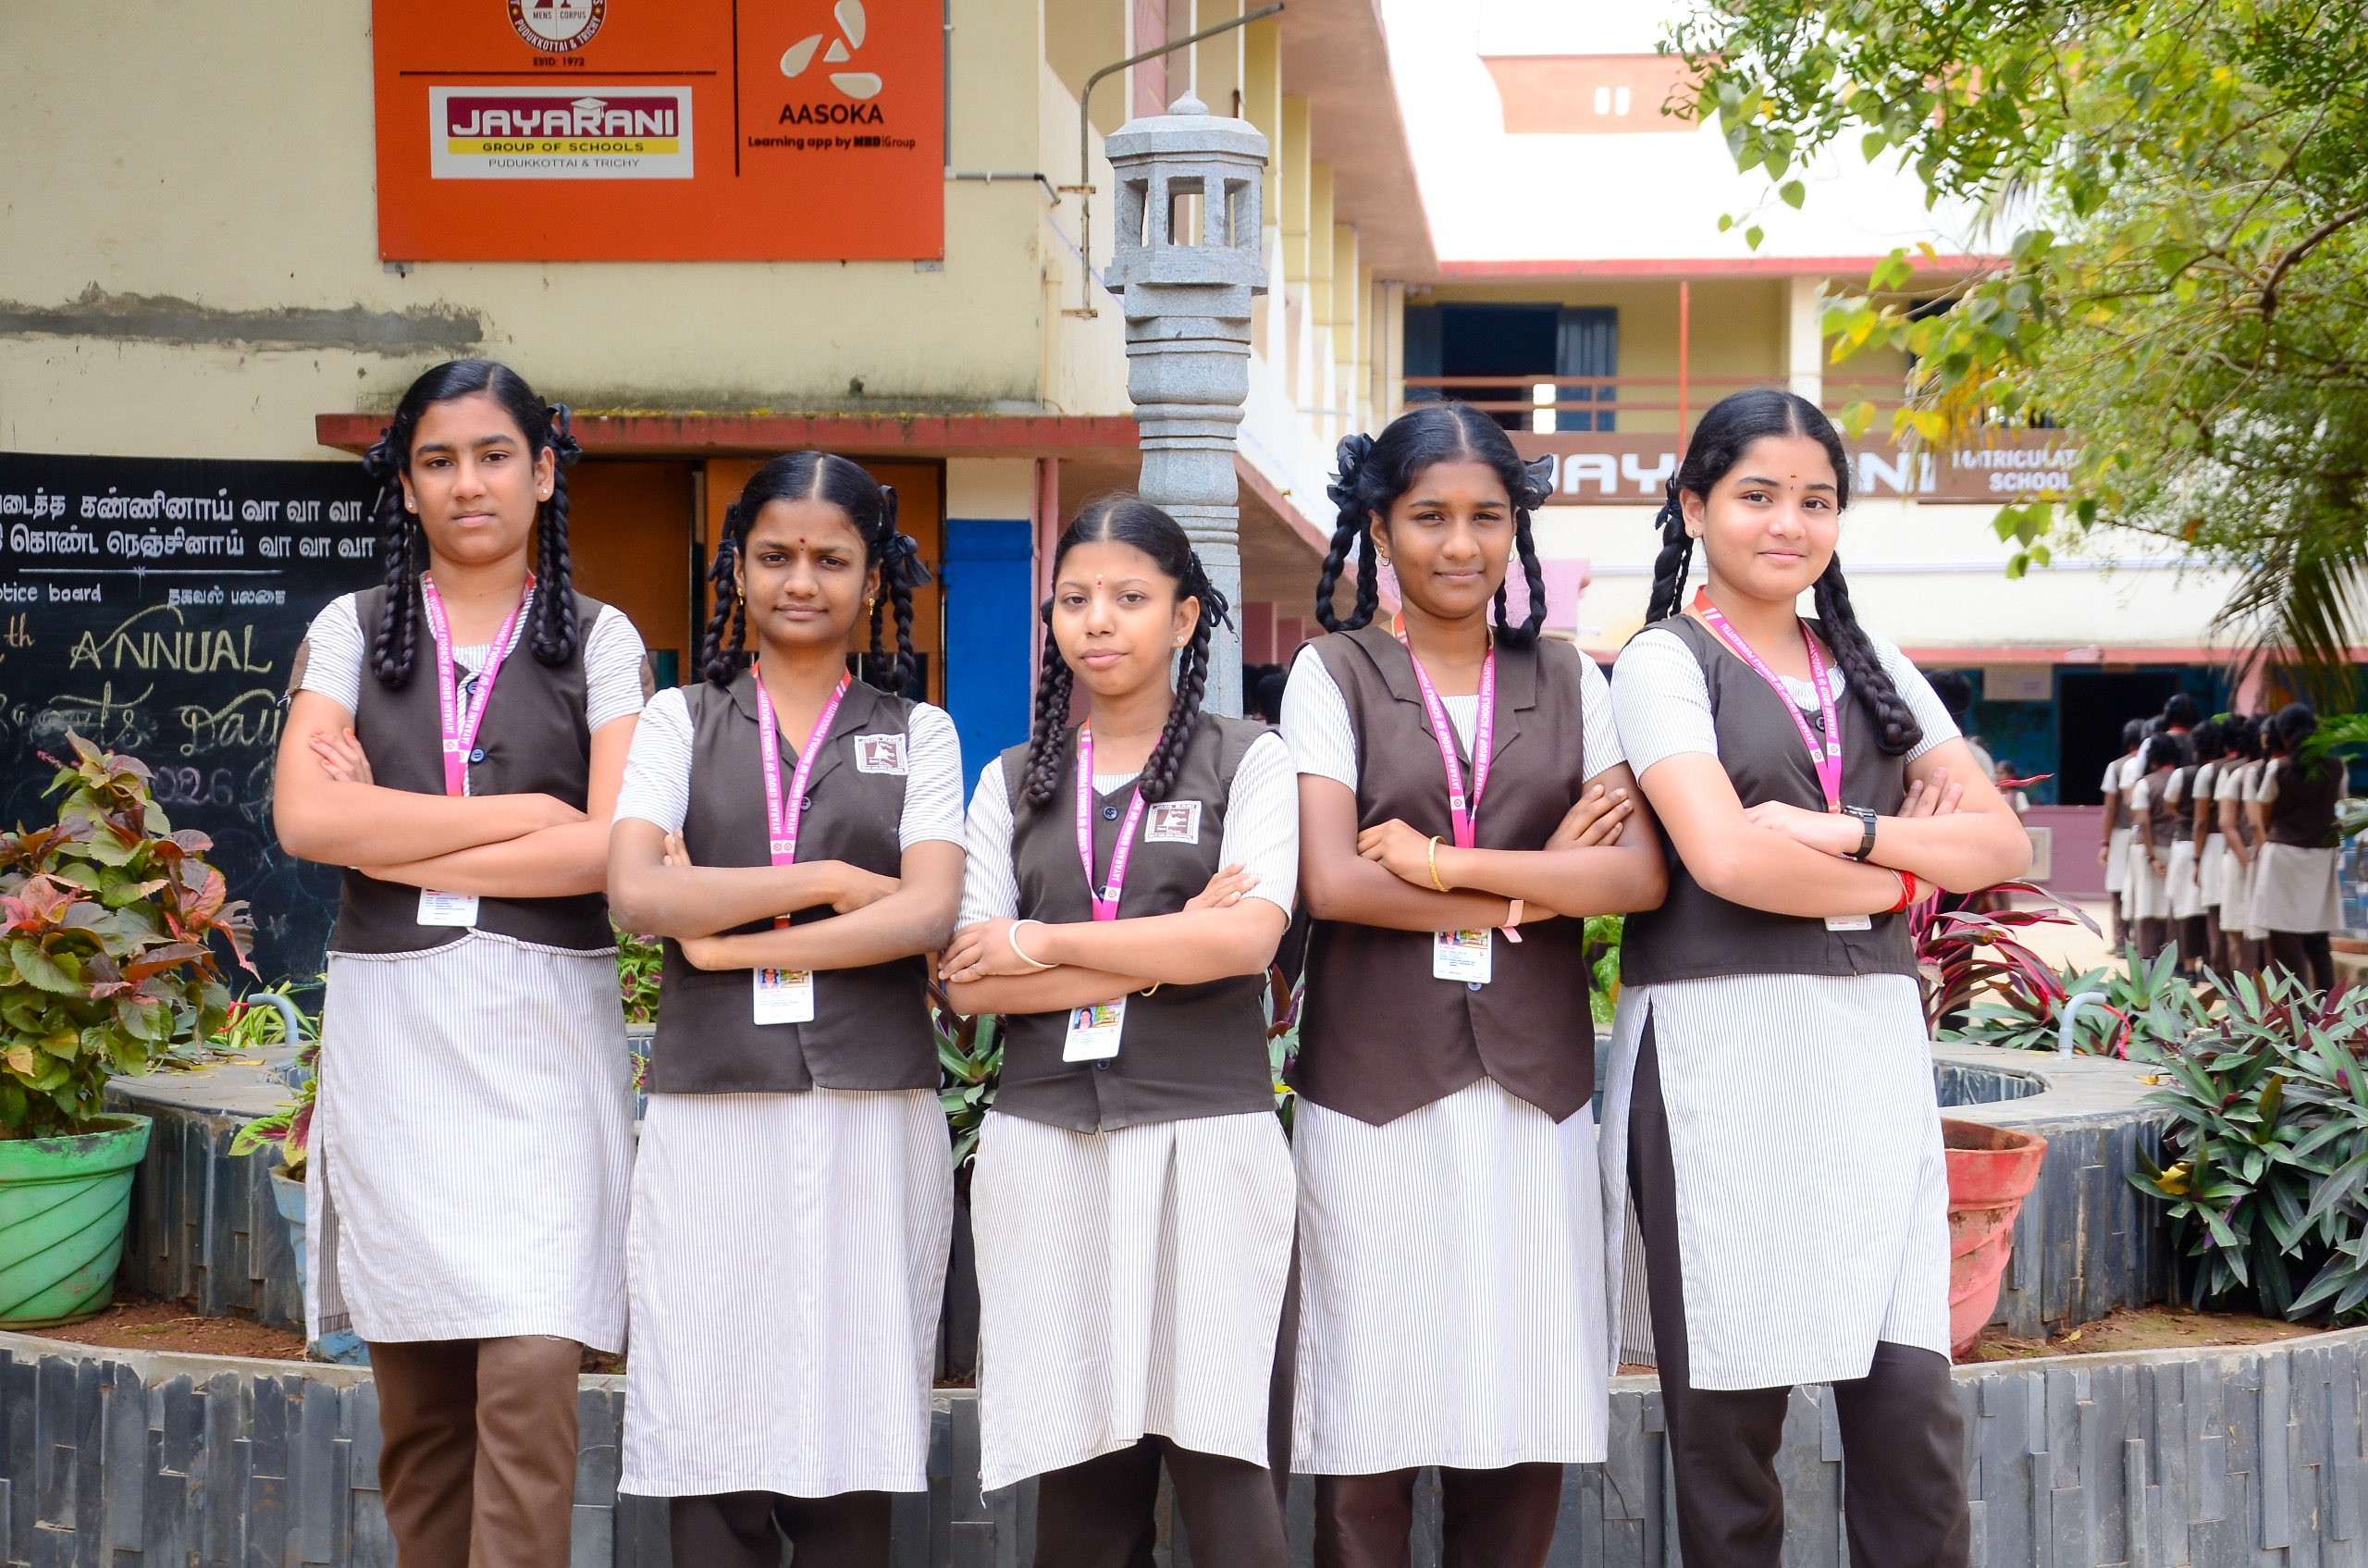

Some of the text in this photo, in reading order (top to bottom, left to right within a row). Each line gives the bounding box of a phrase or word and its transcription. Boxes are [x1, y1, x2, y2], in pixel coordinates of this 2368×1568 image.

[533, 10, 586, 19] MENS CORPUS
[514, 15, 601, 53] PUDUKKOTTAI & TRICHY
[562, 56, 586, 67] 1972
[451, 106, 674, 136] JAYARANI
[778, 104, 884, 125] AASOKA
[482, 142, 645, 152] GROUP OF SCHOOLS
[748, 135, 805, 150] Learning
[807, 137, 832, 151] app
[835, 135, 851, 151] by
[884, 135, 917, 151] Group
[488, 158, 640, 167] PUDUKKOTTAI & TRICHY
[1989, 471, 2073, 492] SCHOOL
[0, 487, 66, 520] டைத்த
[80, 486, 233, 522] கண்ணினாய்
[241, 499, 279, 522] வா
[286, 500, 320, 523] வா
[10, 523, 99, 553] கொண்ட
[106, 526, 244, 560] நெஞ்சினாய்
[259, 536, 291, 558] வா
[299, 536, 331, 558] வா
[338, 537, 376, 558] வா
[0, 581, 102, 603] tice board
[168, 585, 287, 608] தகவல் பலகை
[69, 608, 273, 674] ANNUAL
[438, 634, 450, 664] SCHOOLS
[441, 665, 450, 675] OF
[484, 647, 501, 676] SCHOOLS
[441, 676, 452, 700] GROUP
[480, 676, 490, 686] OF
[1720, 623, 1817, 744] JAYARANI GROUP OF SCHOOLS PUDUKKOTTAI
[472, 686, 487, 710] GROUP
[1819, 685, 1832, 707] GROUP
[444, 701, 455, 734] JAYARANI
[1480, 697, 1491, 728] SCHOOLS
[461, 711, 478, 745] JAYARANI
[1425, 688, 1461, 791] JAYARANI GROUP OF SCHOOLS
[1480, 728, 1488, 738] OF
[763, 730, 774, 761] SCHOOLS
[1478, 738, 1488, 764] GROUP
[766, 762, 775, 772] OF
[786, 700, 839, 834] JAYARANI GROUP OF SCHOOLS PUDUKKOTTAI
[767, 772, 778, 798] GROUP
[1474, 765, 1486, 799] JAYARANI
[770, 799, 782, 834] JAYARANI
[1078, 818, 1088, 827] OF
[1078, 827, 1088, 852] GROUP
[1112, 846, 1128, 883] JAYARANI
[1120, 821, 1134, 846] GROUP
[1129, 810, 1139, 821] OF
